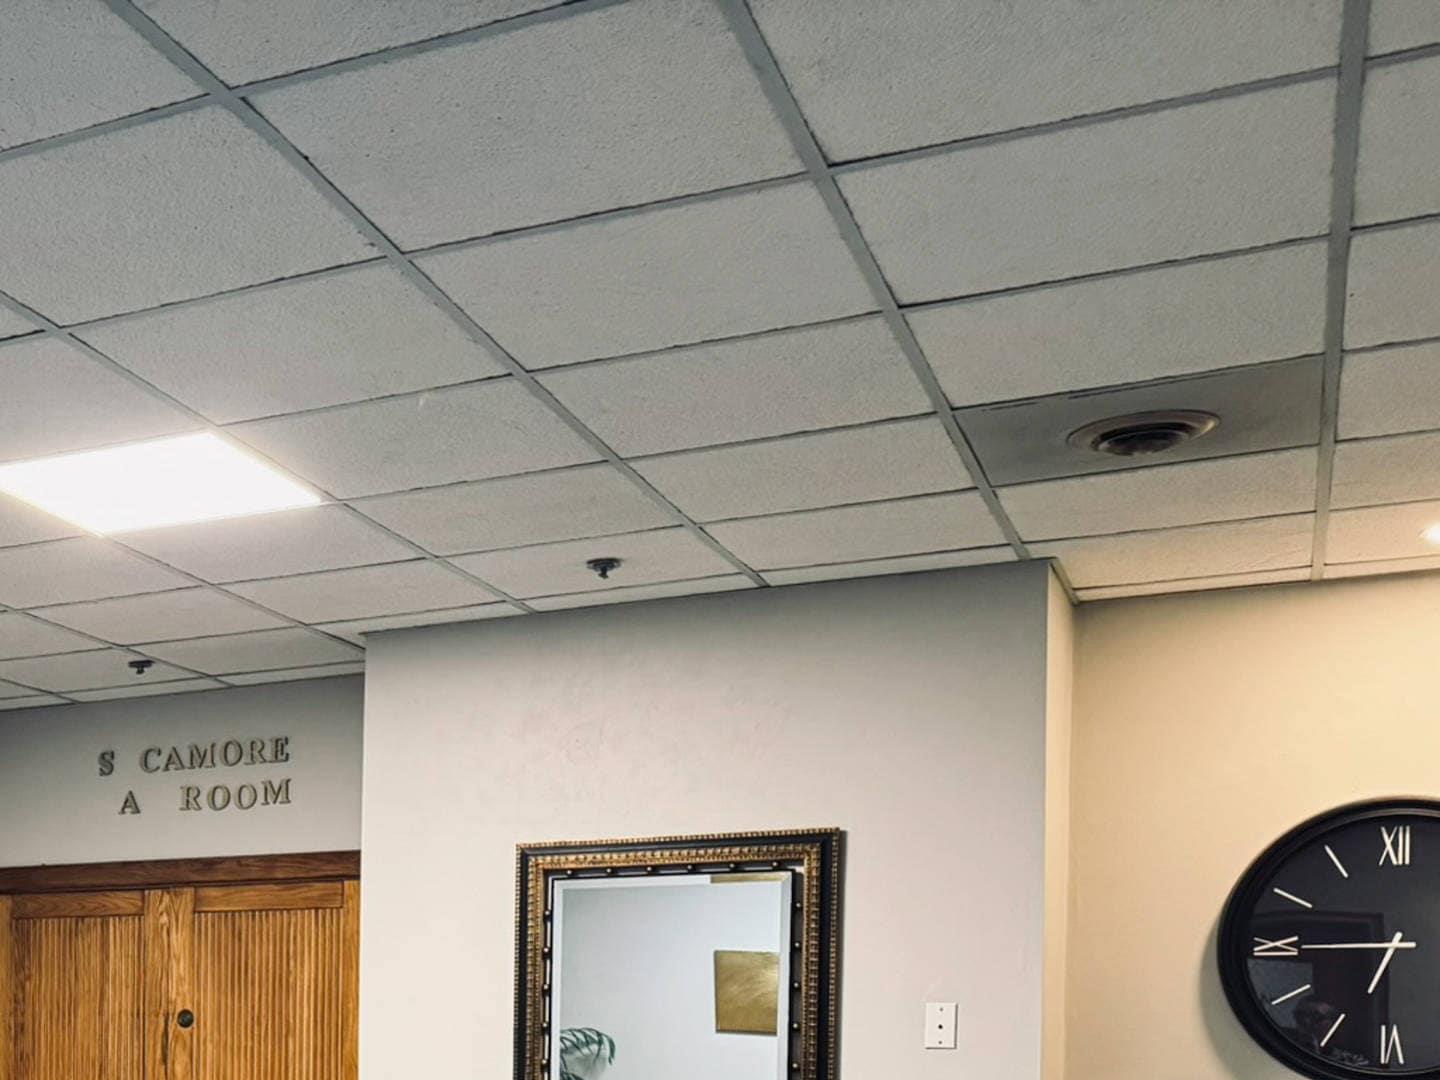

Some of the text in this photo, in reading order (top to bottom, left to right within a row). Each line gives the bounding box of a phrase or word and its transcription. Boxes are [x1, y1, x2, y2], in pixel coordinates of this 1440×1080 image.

[118, 778, 292, 815] A ROOM
[1378, 825, 1411, 866] XII
